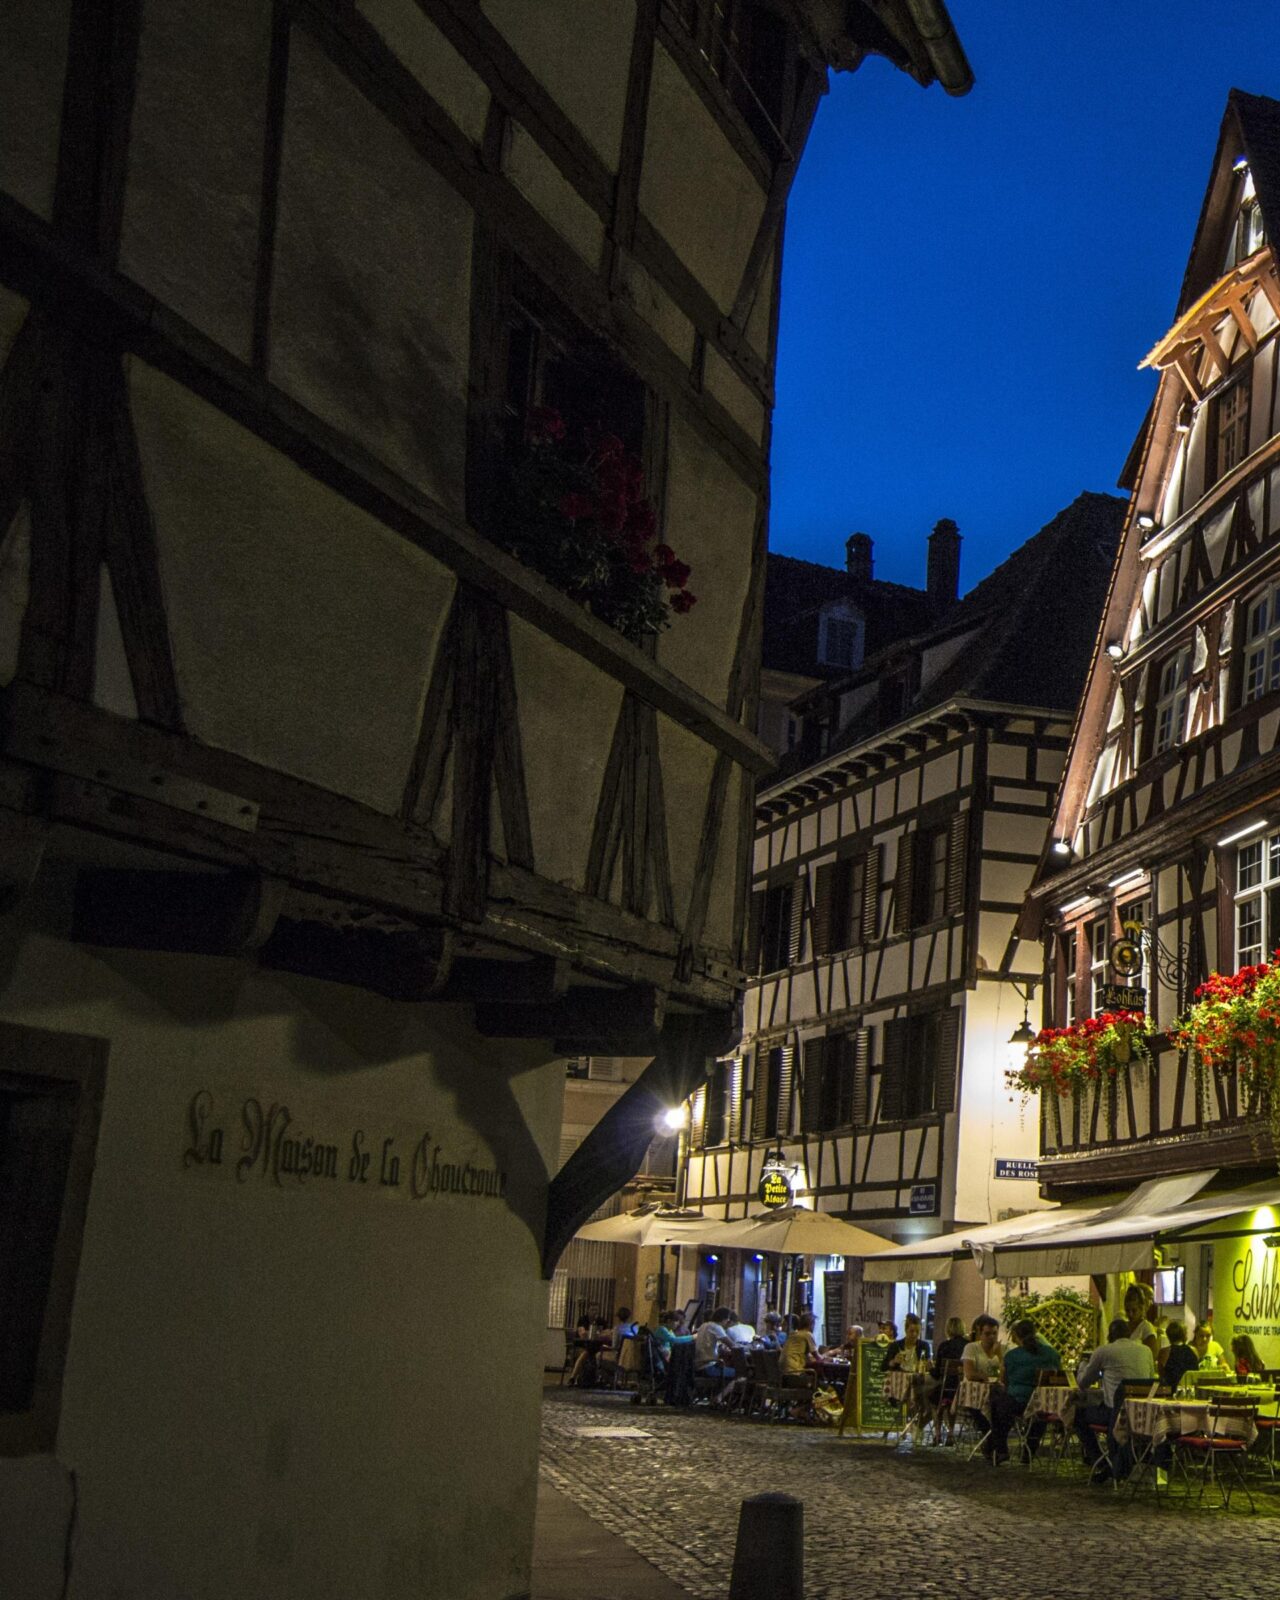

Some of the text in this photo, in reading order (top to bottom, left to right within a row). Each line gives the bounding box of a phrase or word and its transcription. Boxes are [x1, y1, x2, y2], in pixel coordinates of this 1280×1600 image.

[183, 1090, 224, 1168] La
[236, 1099, 338, 1188] Maison
[348, 1130, 370, 1187] de
[379, 1137, 400, 1187] la
[770, 1172, 782, 1184] La
[1000, 1169, 1039, 1178] DES ROSE
[764, 1183, 788, 1193] Petite
[764, 1194, 787, 1203] Alsace
